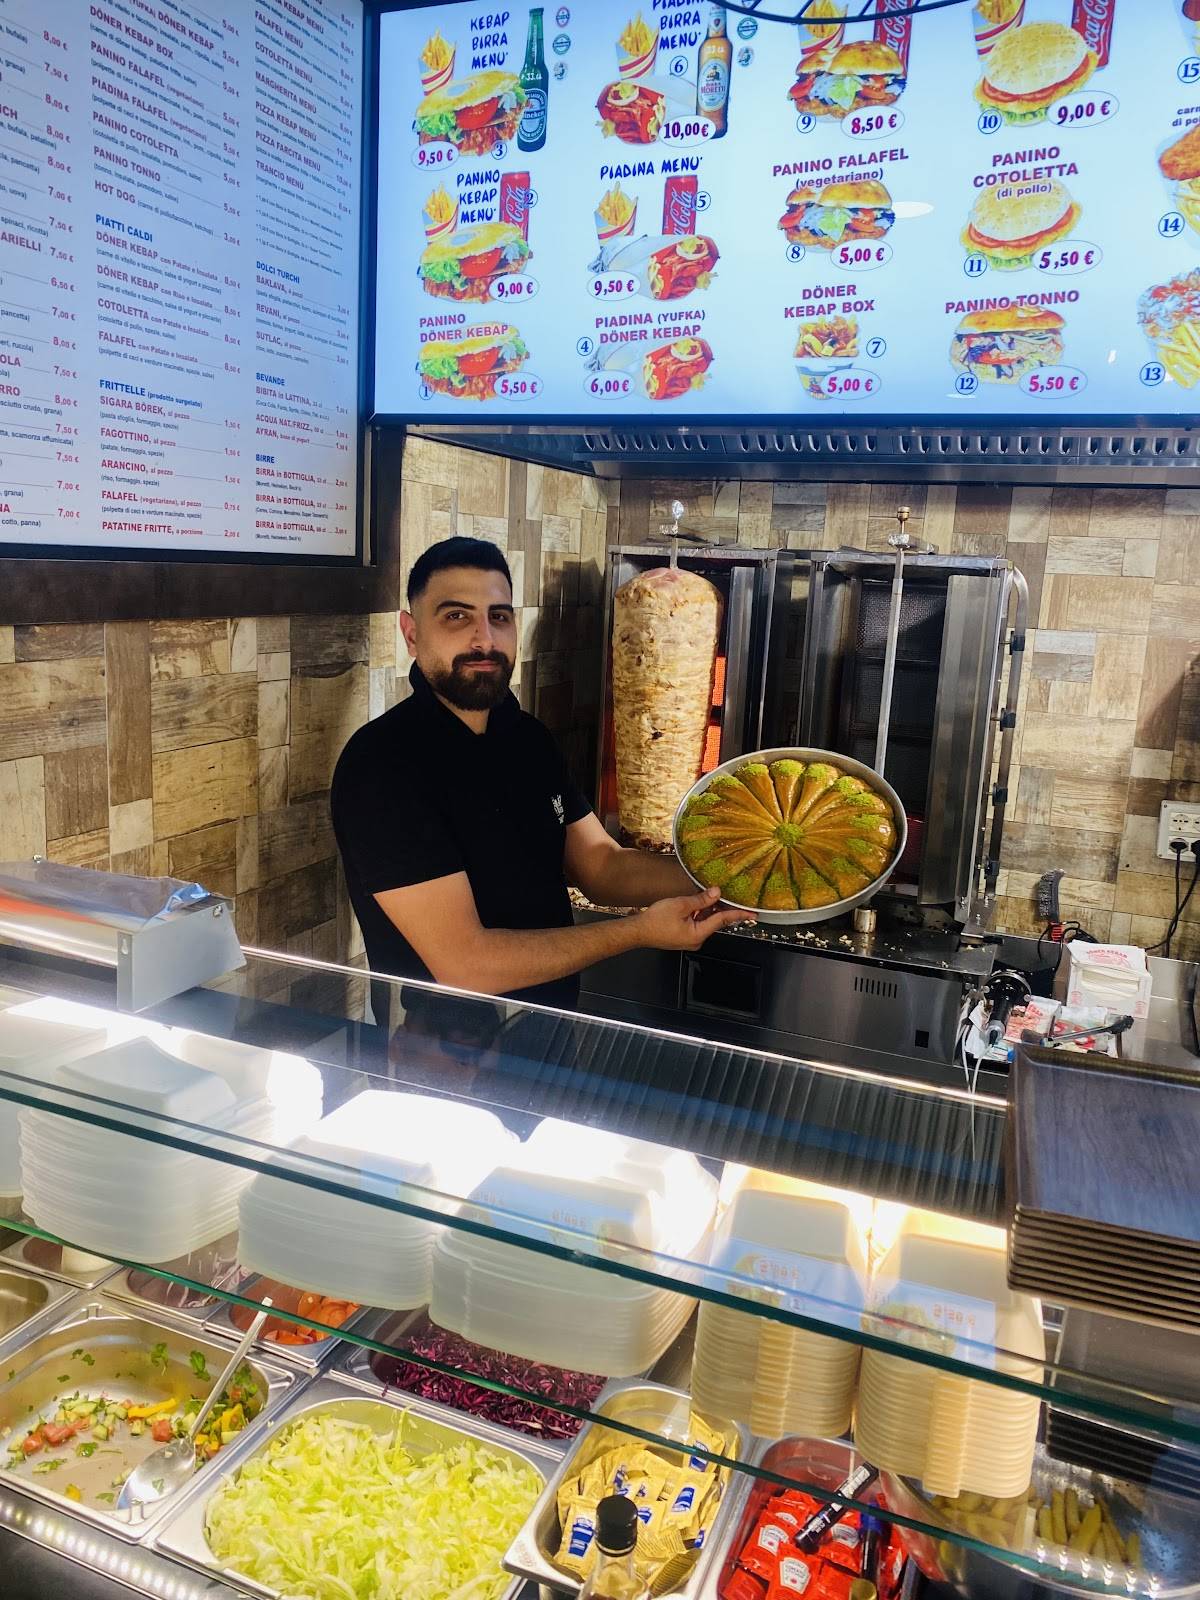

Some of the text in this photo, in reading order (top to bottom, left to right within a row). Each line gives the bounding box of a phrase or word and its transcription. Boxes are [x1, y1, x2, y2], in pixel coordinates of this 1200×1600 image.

[470, 11, 509, 31] KEBAP
[661, 11, 700, 30] BIRRA
[90, 6, 174, 60] DÖNER KEBAP BOX
[188, 30, 214, 50] KEBAP
[472, 32, 508, 50] BIRRA
[255, 41, 293, 70] COTOLETTA
[91, 41, 126, 66] PANINO
[128, 60, 165, 88] FALAFEL
[675, 60, 683, 73] 6
[92, 76, 168, 121] PIADINA FALAFEL
[1057, 101, 1110, 125] 9,00 €
[801, 116, 811, 130] 9
[851, 114, 897, 134] 8,50 €
[982, 115, 998, 129] 10
[93, 111, 127, 134] PANINO
[130, 128, 179, 158] COTOLETTA
[664, 122, 708, 140] 10,00 €
[418, 149, 452, 166] 9,50 €
[496, 145, 503, 156] 3
[992, 146, 1060, 167] PANINO
[94, 146, 160, 182] PANINO TONNO
[773, 148, 909, 176] PANINO FALAFEL
[457, 170, 500, 187] PANINO
[600, 161, 654, 180] PIADINA
[973, 162, 1078, 188] COTOLETTA
[796, 168, 884, 190] (vegetariano)
[95, 180, 135, 203] HOT DOG
[459, 189, 497, 205] KEBAP
[527, 193, 533, 204] 2
[997, 183, 1052, 200] (di pollo)
[698, 195, 706, 207] 5
[96, 214, 124, 232] PIATTI
[127, 226, 153, 242] CALDI
[1163, 218, 1180, 232] 14
[96, 231, 158, 259] DÖNER KEBAP
[791, 245, 800, 259] 8
[839, 247, 884, 264] 5,00 €
[1085, 251, 1094, 265] €
[256, 261, 300, 283] DOLCI TURCHI
[968, 260, 982, 272] 11
[97, 265, 159, 290] DÖNER KEBAP
[498, 282, 533, 297] 9,00 €
[594, 280, 634, 295] 9,50 €
[802, 284, 857, 300] DÖNER
[98, 298, 149, 320] COTOLETTA
[784, 300, 875, 318] KEBAP BOX
[945, 290, 1079, 314] PANINO TONNO
[420, 314, 466, 327] PANINO
[595, 310, 705, 328] PIADINA (YUFKA)
[99, 331, 136, 348] FALAFEL
[420, 325, 508, 342] DÖNER KEBAP
[600, 325, 701, 343] DÖNER KEBAP
[581, 341, 588, 352] 4
[872, 341, 881, 354] 7
[256, 373, 285, 386] BEVANDE
[1144, 367, 1161, 380] 13
[100, 379, 145, 396] FRITTELLE
[424, 386, 428, 397] 1
[501, 379, 537, 395] 5,50 €
[591, 379, 629, 395] 6,00 €
[828, 377, 873, 393] 5,00 €
[960, 378, 974, 389] 12
[1029, 375, 1078, 393] 5,50 €
[256, 386, 277, 398] BIBITA
[100, 396, 132, 410] SIGARA
[256, 414, 277, 425] ACQUA
[101, 428, 151, 443] FAGOTTINO,
[256, 428, 279, 439] AYRAN,
[102, 460, 148, 473] ARANCINO,
[256, 454, 275, 463] BIRRE
[256, 468, 275, 477] BIRRA
[58, 481, 73, 490] 7,00
[102, 490, 138, 501] FALAFEL
[256, 494, 275, 503] BIRRA
[58, 509, 73, 518] 7,00
[102, 522, 174, 535] PATATINE FRITTE,
[256, 521, 275, 529] BIRRA
